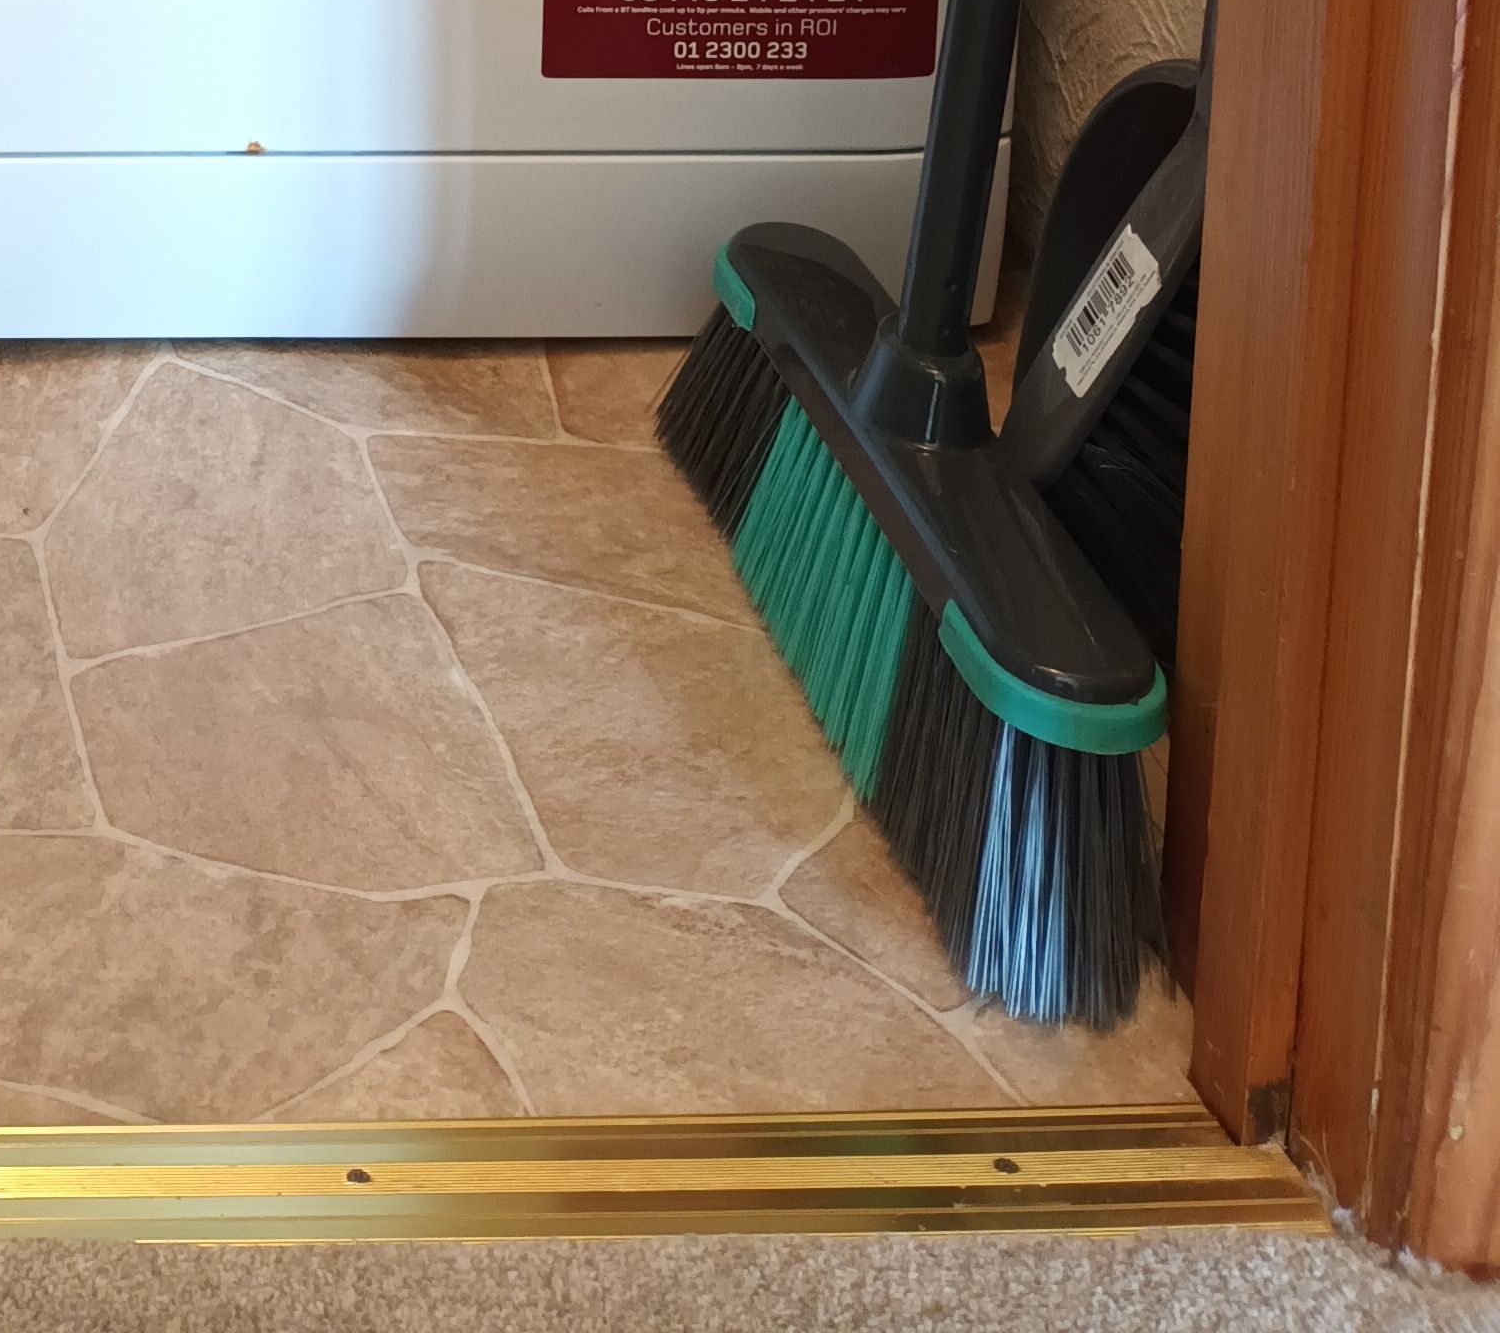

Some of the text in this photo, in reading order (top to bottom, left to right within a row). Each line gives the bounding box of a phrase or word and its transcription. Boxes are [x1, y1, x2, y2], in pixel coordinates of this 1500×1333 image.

[646, 18, 837, 36] Customers in ROI
[673, 41, 808, 59] 01 2300 233
[1081, 318, 1107, 353] 1061
[1107, 275, 1136, 314] 7892
